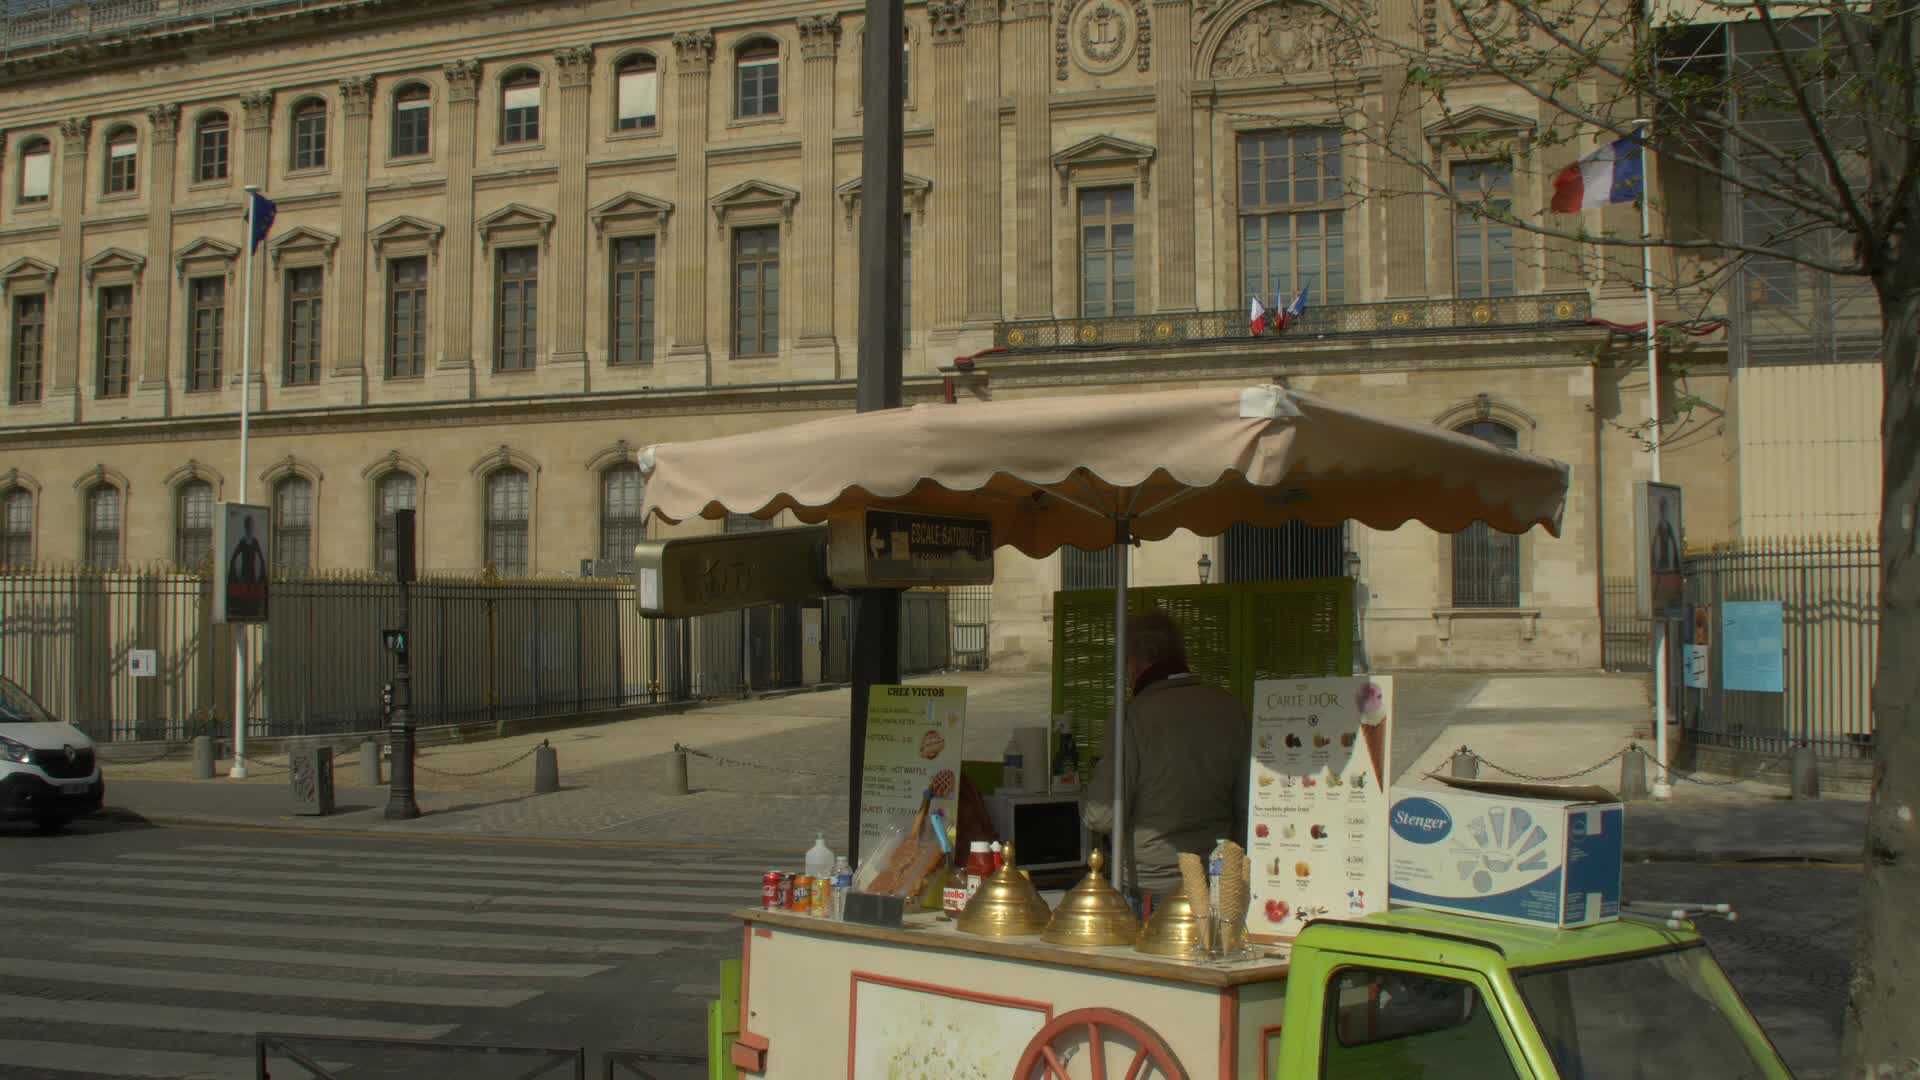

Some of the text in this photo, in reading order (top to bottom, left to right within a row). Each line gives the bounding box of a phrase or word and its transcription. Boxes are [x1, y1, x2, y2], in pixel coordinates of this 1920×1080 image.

[888, 687, 945, 697] CHEZ VICTOR
[1267, 693, 1305, 709] CARTE
[1395, 810, 1447, 830] Stenger
